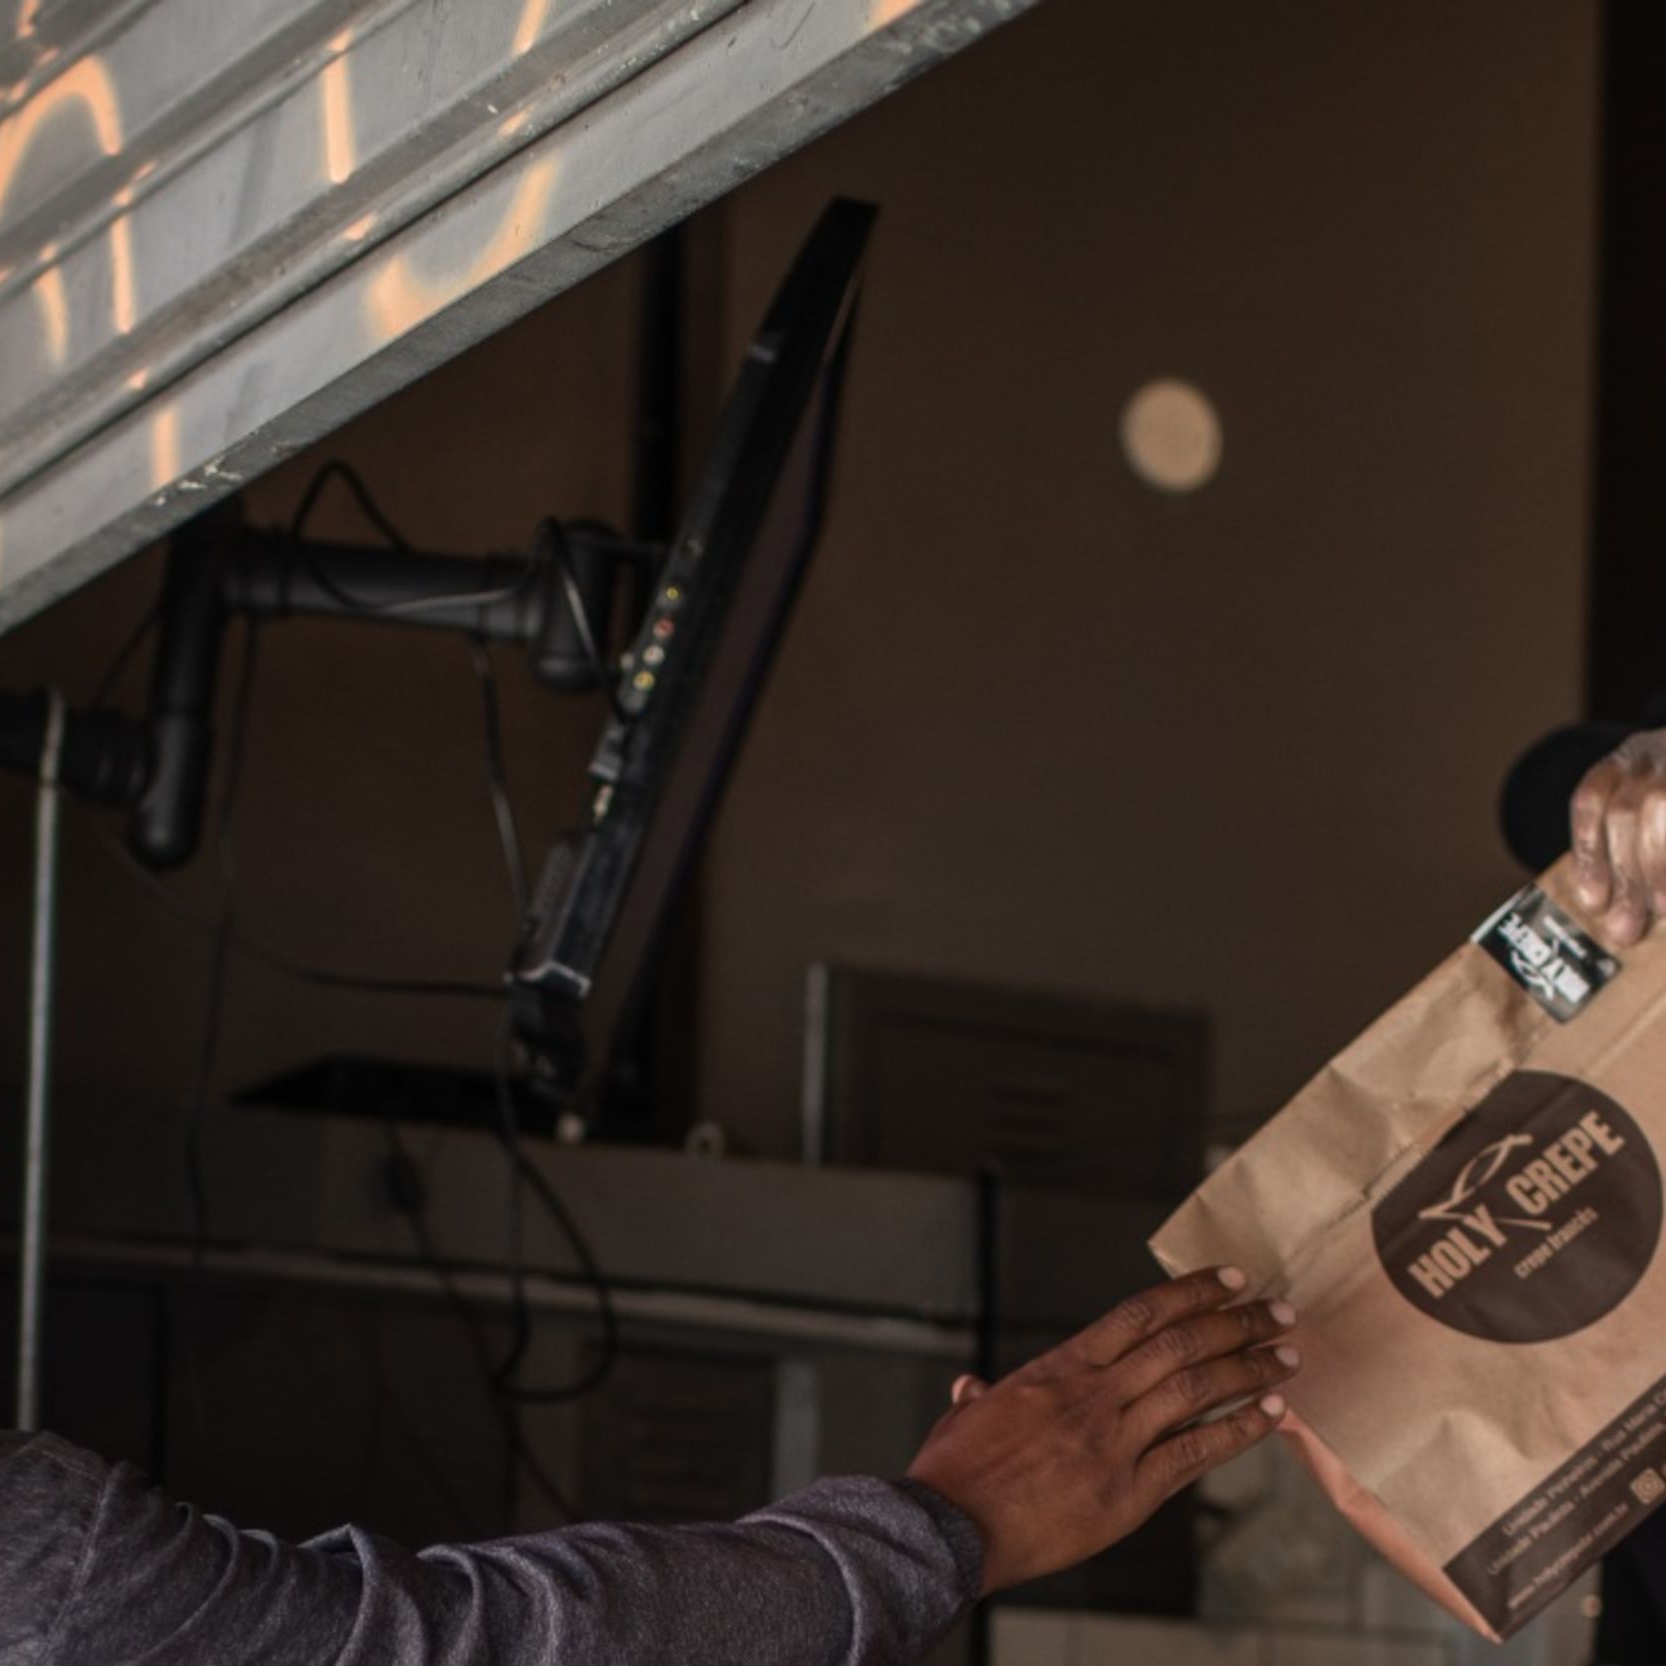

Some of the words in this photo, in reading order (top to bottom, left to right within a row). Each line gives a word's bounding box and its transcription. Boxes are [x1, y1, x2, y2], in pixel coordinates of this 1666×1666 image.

[1407, 1204, 1508, 1299] HOLY
[1505, 1110, 1625, 1215] CREPE
[1513, 1244, 1553, 1279] crepe
